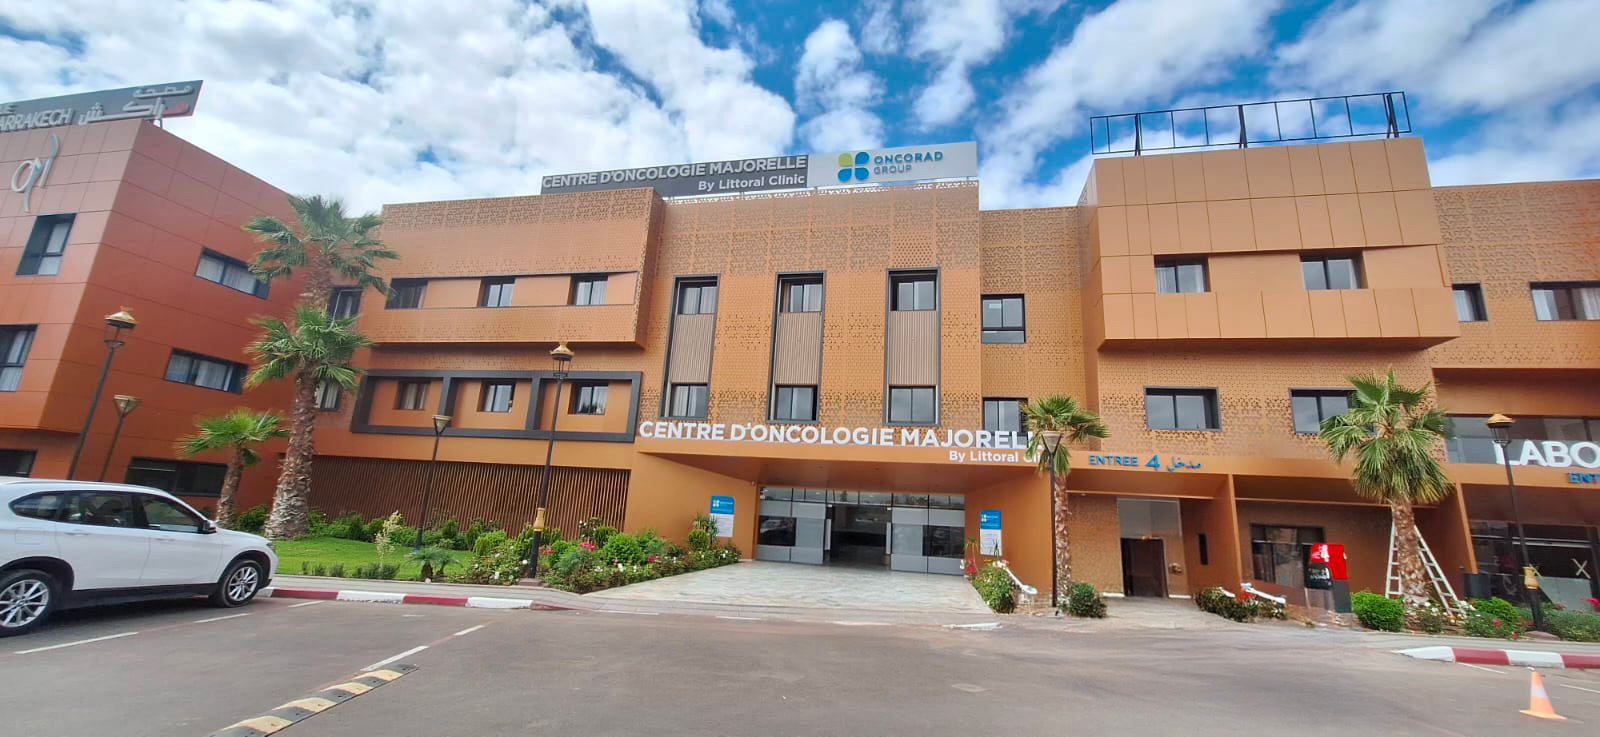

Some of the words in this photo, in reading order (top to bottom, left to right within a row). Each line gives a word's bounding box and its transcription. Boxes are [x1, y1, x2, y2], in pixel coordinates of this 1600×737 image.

[873, 151, 943, 165] ONCORAD
[542, 173, 597, 188] CENTRE
[600, 163, 706, 184] D'ONCOLOGIE
[709, 156, 806, 175] MAJORELLE
[873, 164, 912, 175] GROUP
[698, 180, 715, 192] By
[719, 177, 765, 190] Littoral
[768, 174, 805, 186] Clinic
[639, 420, 725, 440] CENTRE
[730, 422, 895, 447] D'ONCOLOGIE
[901, 428, 1044, 450] MAJORELL
[949, 450, 966, 463] By
[970, 450, 1019, 463] Littoral
[1492, 438, 1600, 469] LABO
[1088, 455, 1139, 467] ENTREE
[1144, 454, 1161, 471] 4
